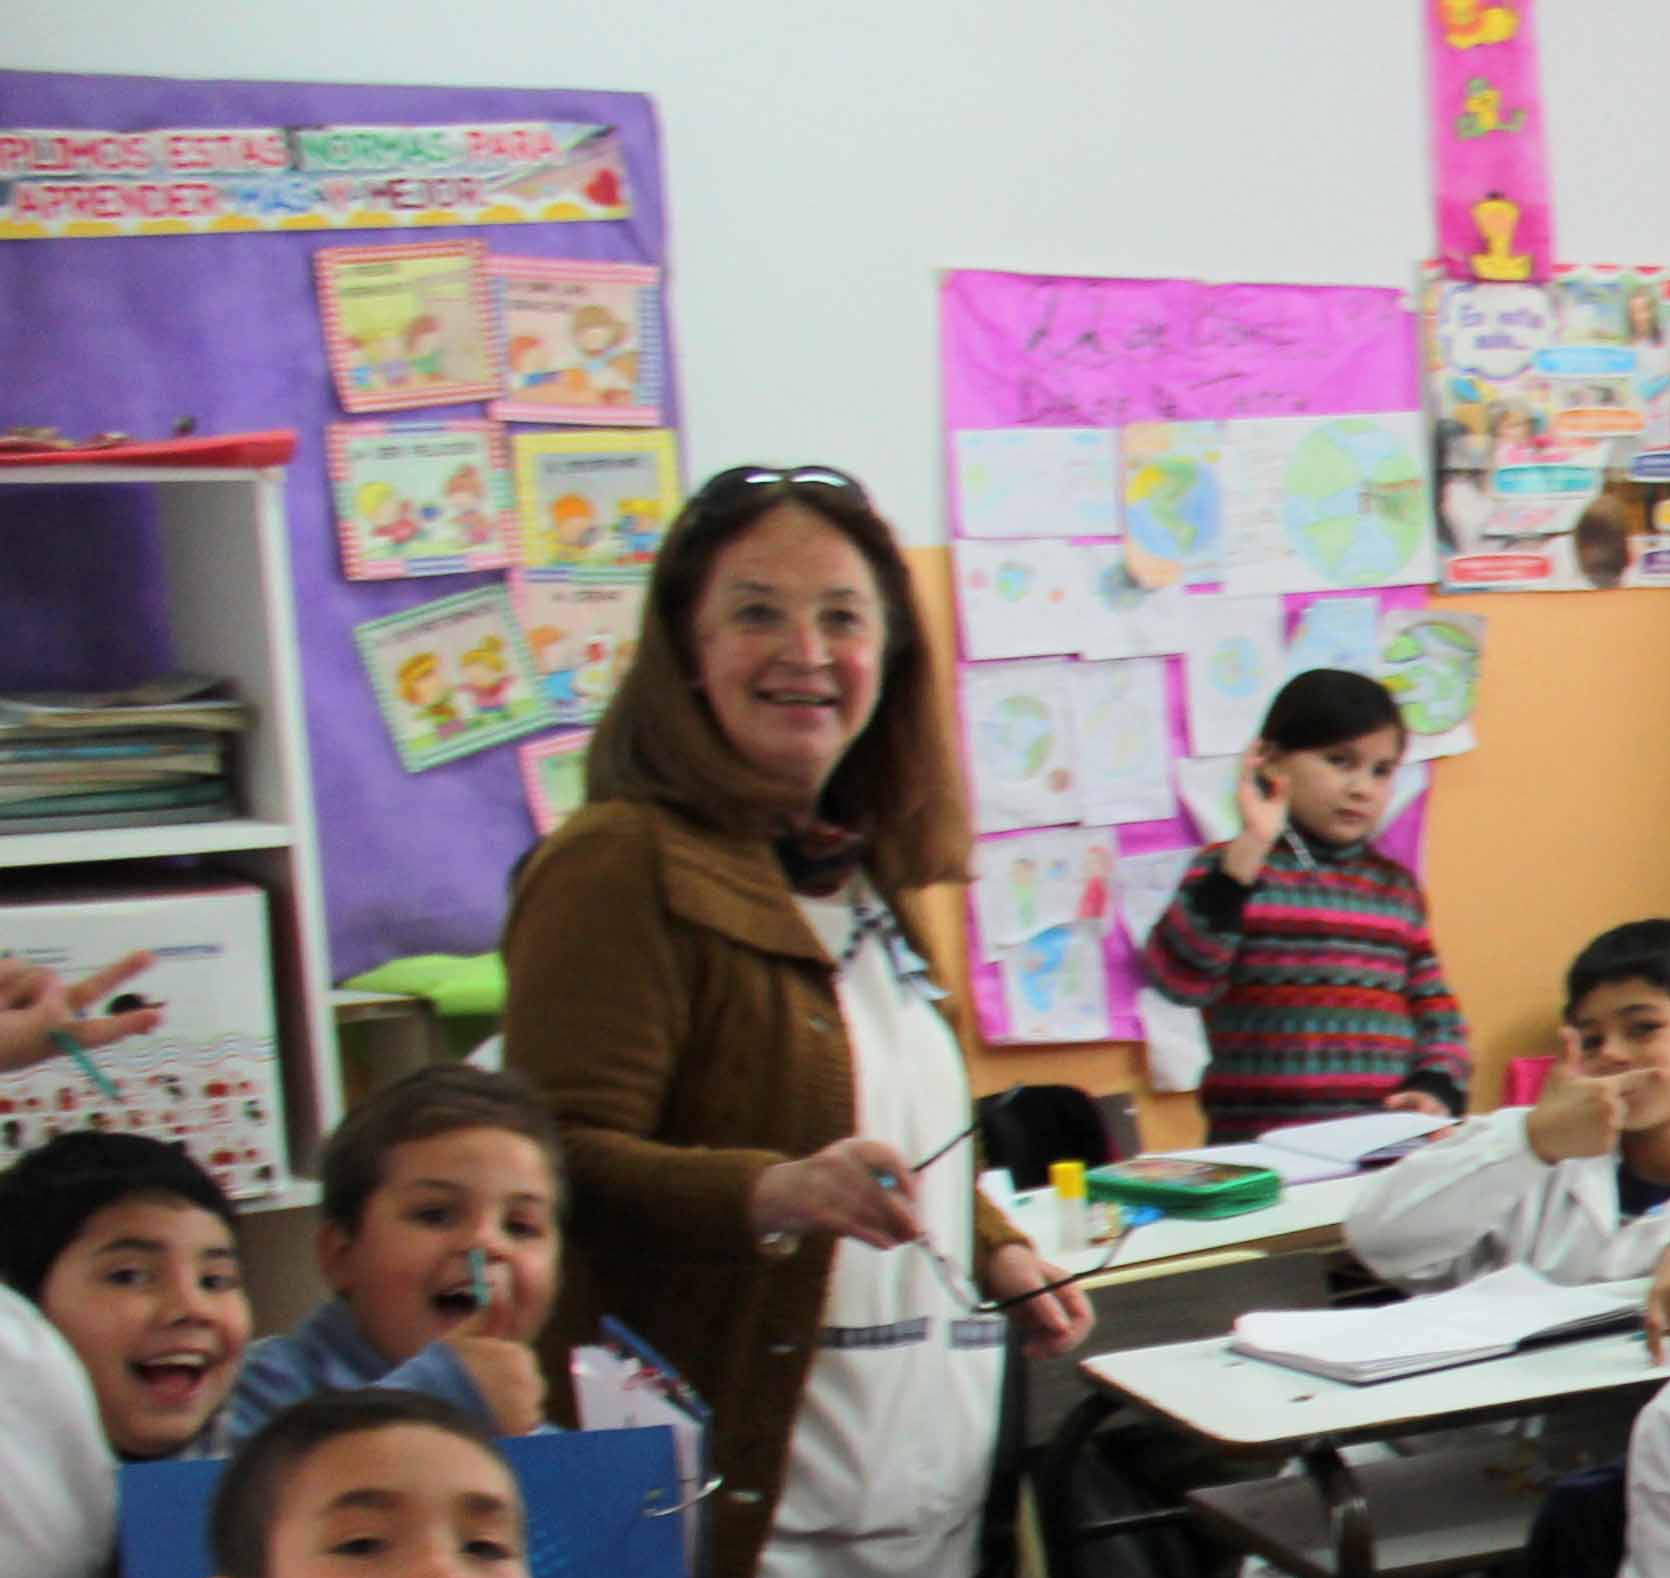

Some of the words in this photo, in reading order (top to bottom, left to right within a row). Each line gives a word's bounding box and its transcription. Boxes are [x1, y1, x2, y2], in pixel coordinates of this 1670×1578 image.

[168, 135, 289, 169] ESTAS
[464, 129, 556, 163] PARA
[16, 182, 222, 219] APRENDER
